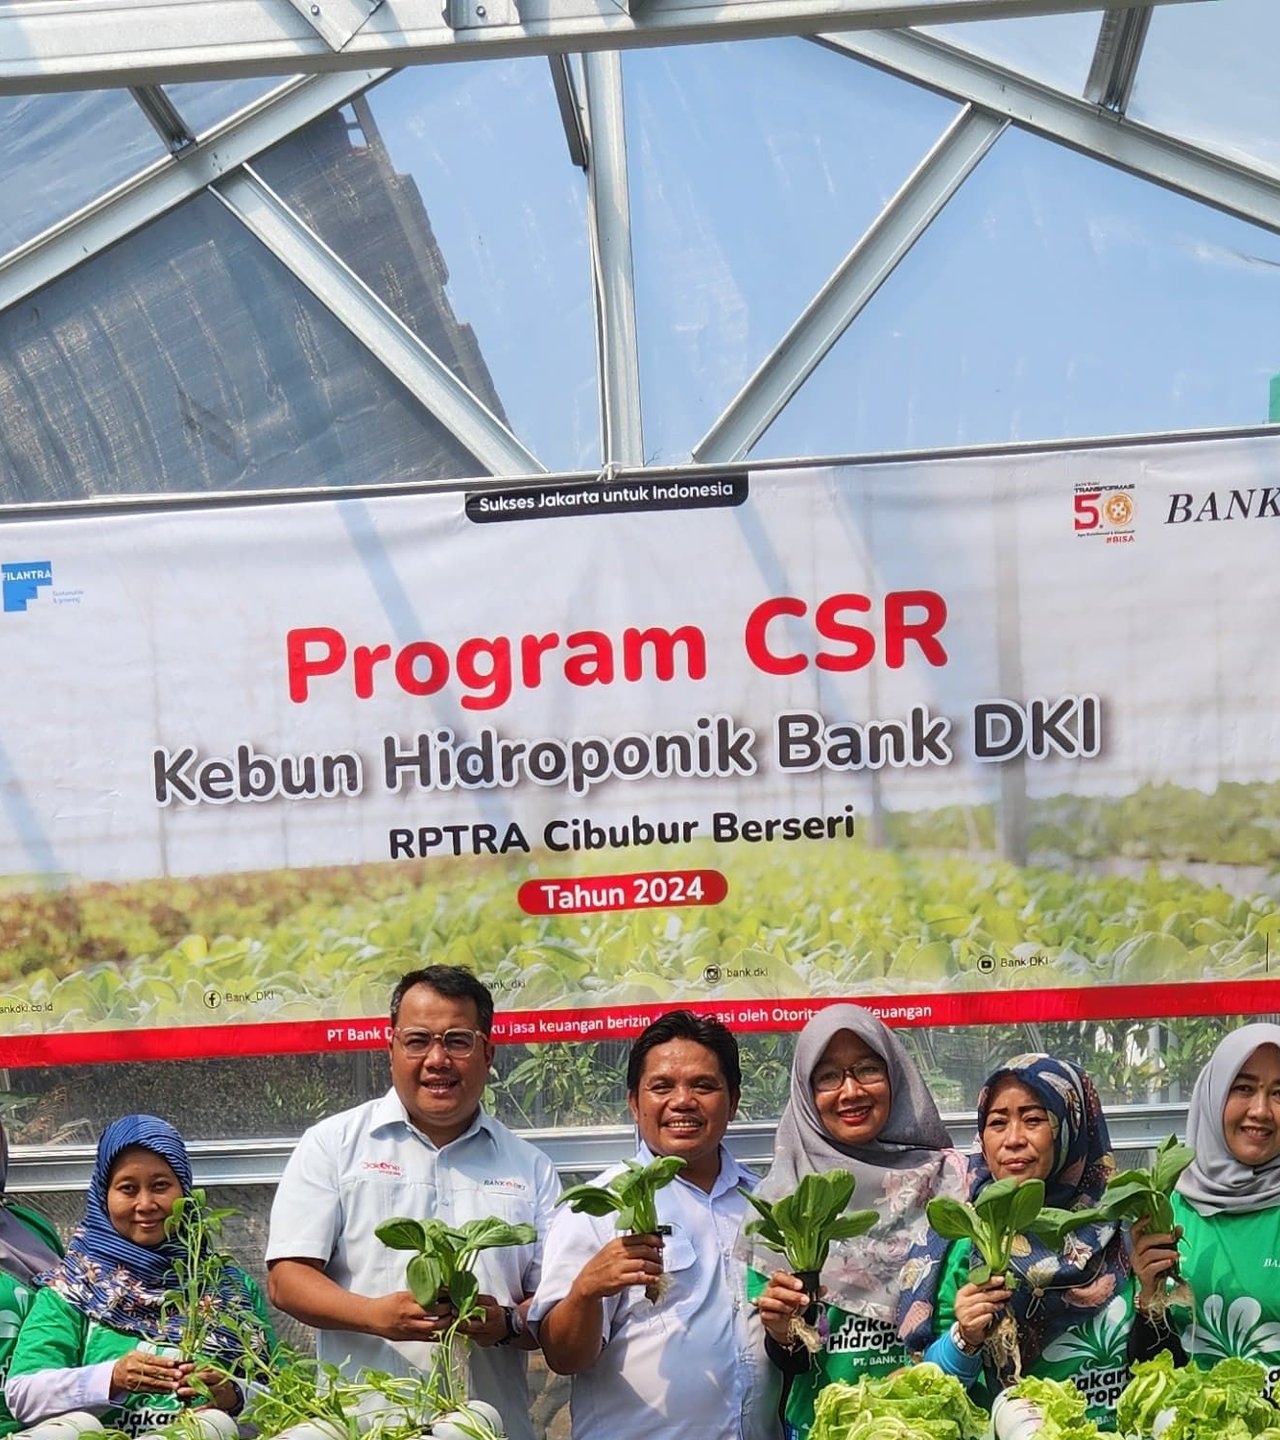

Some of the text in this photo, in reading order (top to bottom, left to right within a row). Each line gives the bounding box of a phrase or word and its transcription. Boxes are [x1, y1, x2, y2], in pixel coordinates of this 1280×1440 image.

[479, 481, 733, 512] Sukses Jakarta untuk Indonesia
[1, 569, 52, 581] FILANTRA
[286, 590, 949, 711] Program CSR
[153, 695, 1100, 805] Kebun Hidroponik Bank DKI
[389, 804, 855, 859] RPTRA Cibubur Berseri
[540, 876, 705, 910] Tahun 2024
[225, 990, 275, 1004] Bank_DKI
[326, 1028, 344, 1042] PT
[347, 1026, 381, 1041] Bank
[508, 1021, 535, 1036] jasa
[539, 1017, 604, 1034] keuangan
[607, 1014, 651, 1029] berizin
[738, 1010, 768, 1022] oleh
[869, 1355, 897, 1365] BANK
